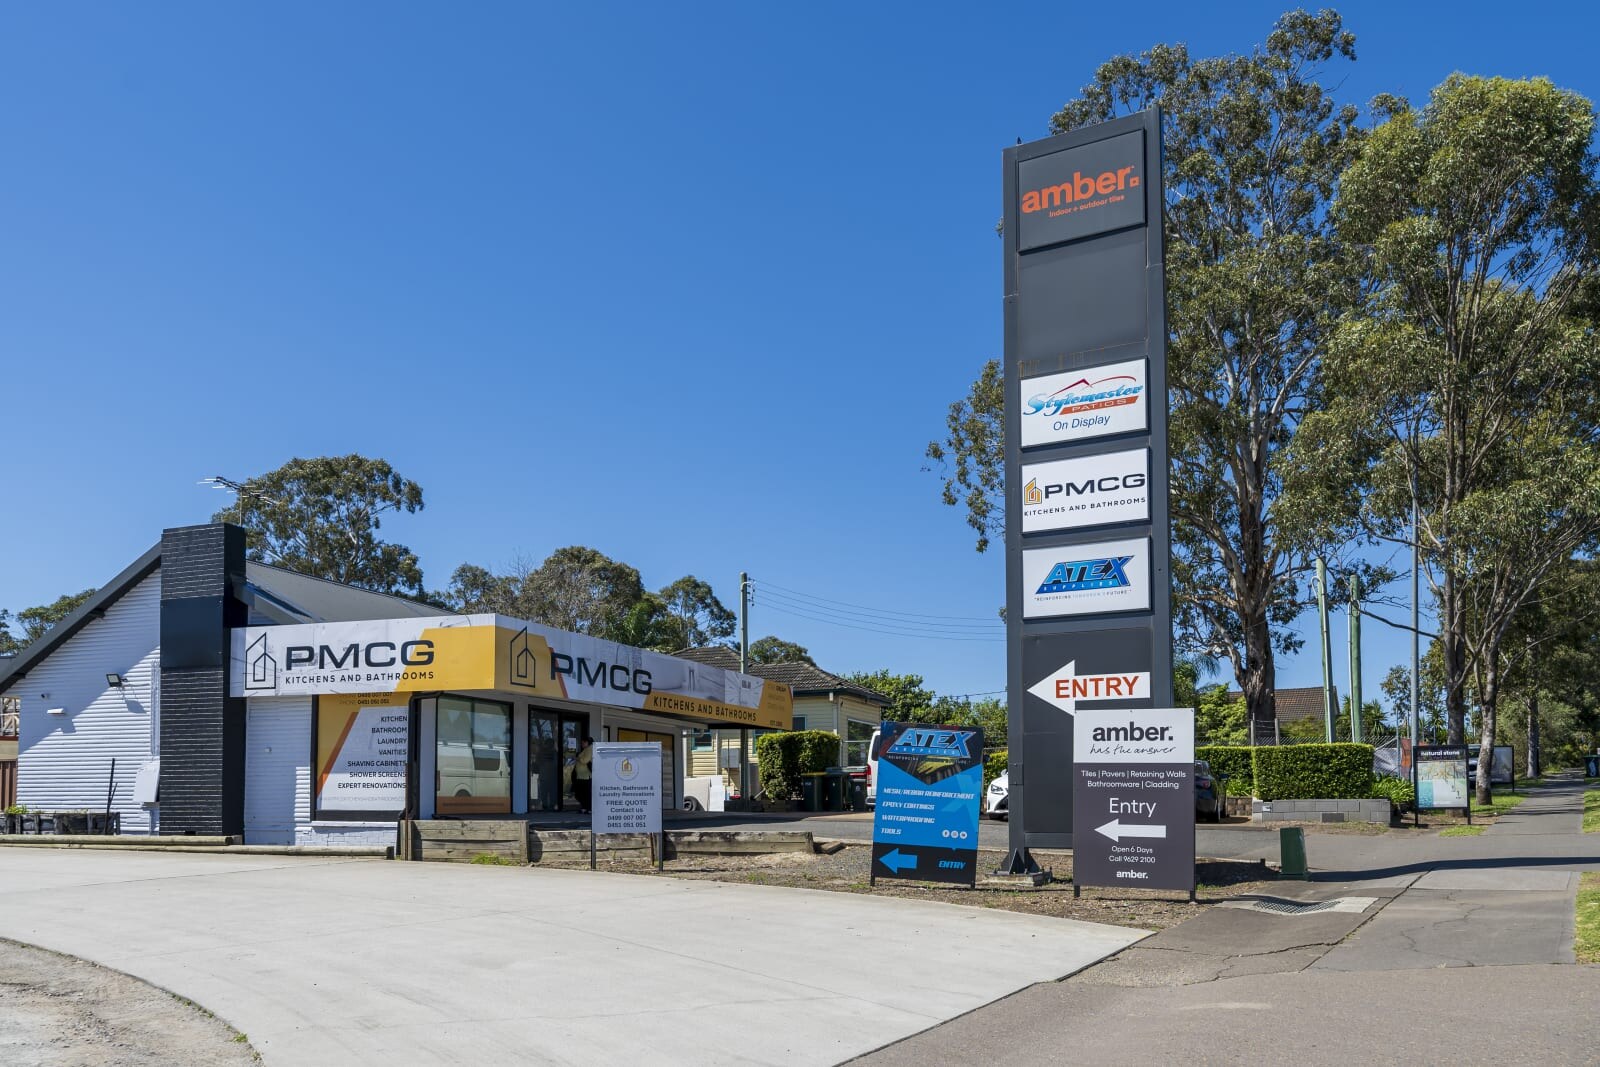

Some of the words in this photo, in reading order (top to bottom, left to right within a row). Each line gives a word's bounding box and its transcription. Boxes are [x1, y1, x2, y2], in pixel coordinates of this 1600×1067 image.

[1048, 208, 1072, 218] indoor
[1080, 199, 1108, 211] outdoor
[1023, 384, 1144, 416] Stylemaster
[1072, 399, 1127, 412] PATIOS
[1053, 421, 1068, 431] On
[1072, 415, 1110, 429] Display
[1044, 473, 1145, 499] PMCG
[1024, 507, 1065, 517] KITCHENS
[1090, 497, 1146, 509] BATHROOMS
[1043, 555, 1135, 587] ATEX
[285, 640, 434, 671] PMCG
[285, 675, 335, 685] KITCHENS
[340, 673, 361, 683] AND
[366, 672, 434, 682] BATHROOMS
[550, 652, 652, 695] PMCG
[1055, 675, 1139, 699] ENTRY
[653, 696, 695, 712] KITCHENS
[697, 704, 713, 715] AND
[716, 706, 757, 721] BATHROOMS
[1092, 721, 1173, 742] amber.
[898, 728, 977, 758] ATEX
[1090, 743, 1110, 755] has
[1113, 743, 1132, 755] the
[1134, 746, 1177, 755] answer
[1101, 770, 1126, 778] Pavers
[1130, 770, 1165, 779] Retaining
[1165, 770, 1187, 778] Walls
[1087, 780, 1140, 788] Bathroomware
[1145, 780, 1180, 790] Cladding
[924, 789, 976, 799] REINFORCEMENT
[882, 801, 903, 809] EPOXY
[903, 802, 936, 810] COATINGS
[1109, 797, 1157, 818] Entry
[881, 814, 936, 824] WATERPROOFING
[881, 827, 902, 835] TOOLS
[1111, 845, 1130, 853] Open
[1136, 846, 1153, 854] Days
[938, 860, 966, 870] ENTRY
[1139, 856, 1156, 864] 2100
[1116, 869, 1149, 879] amber.
